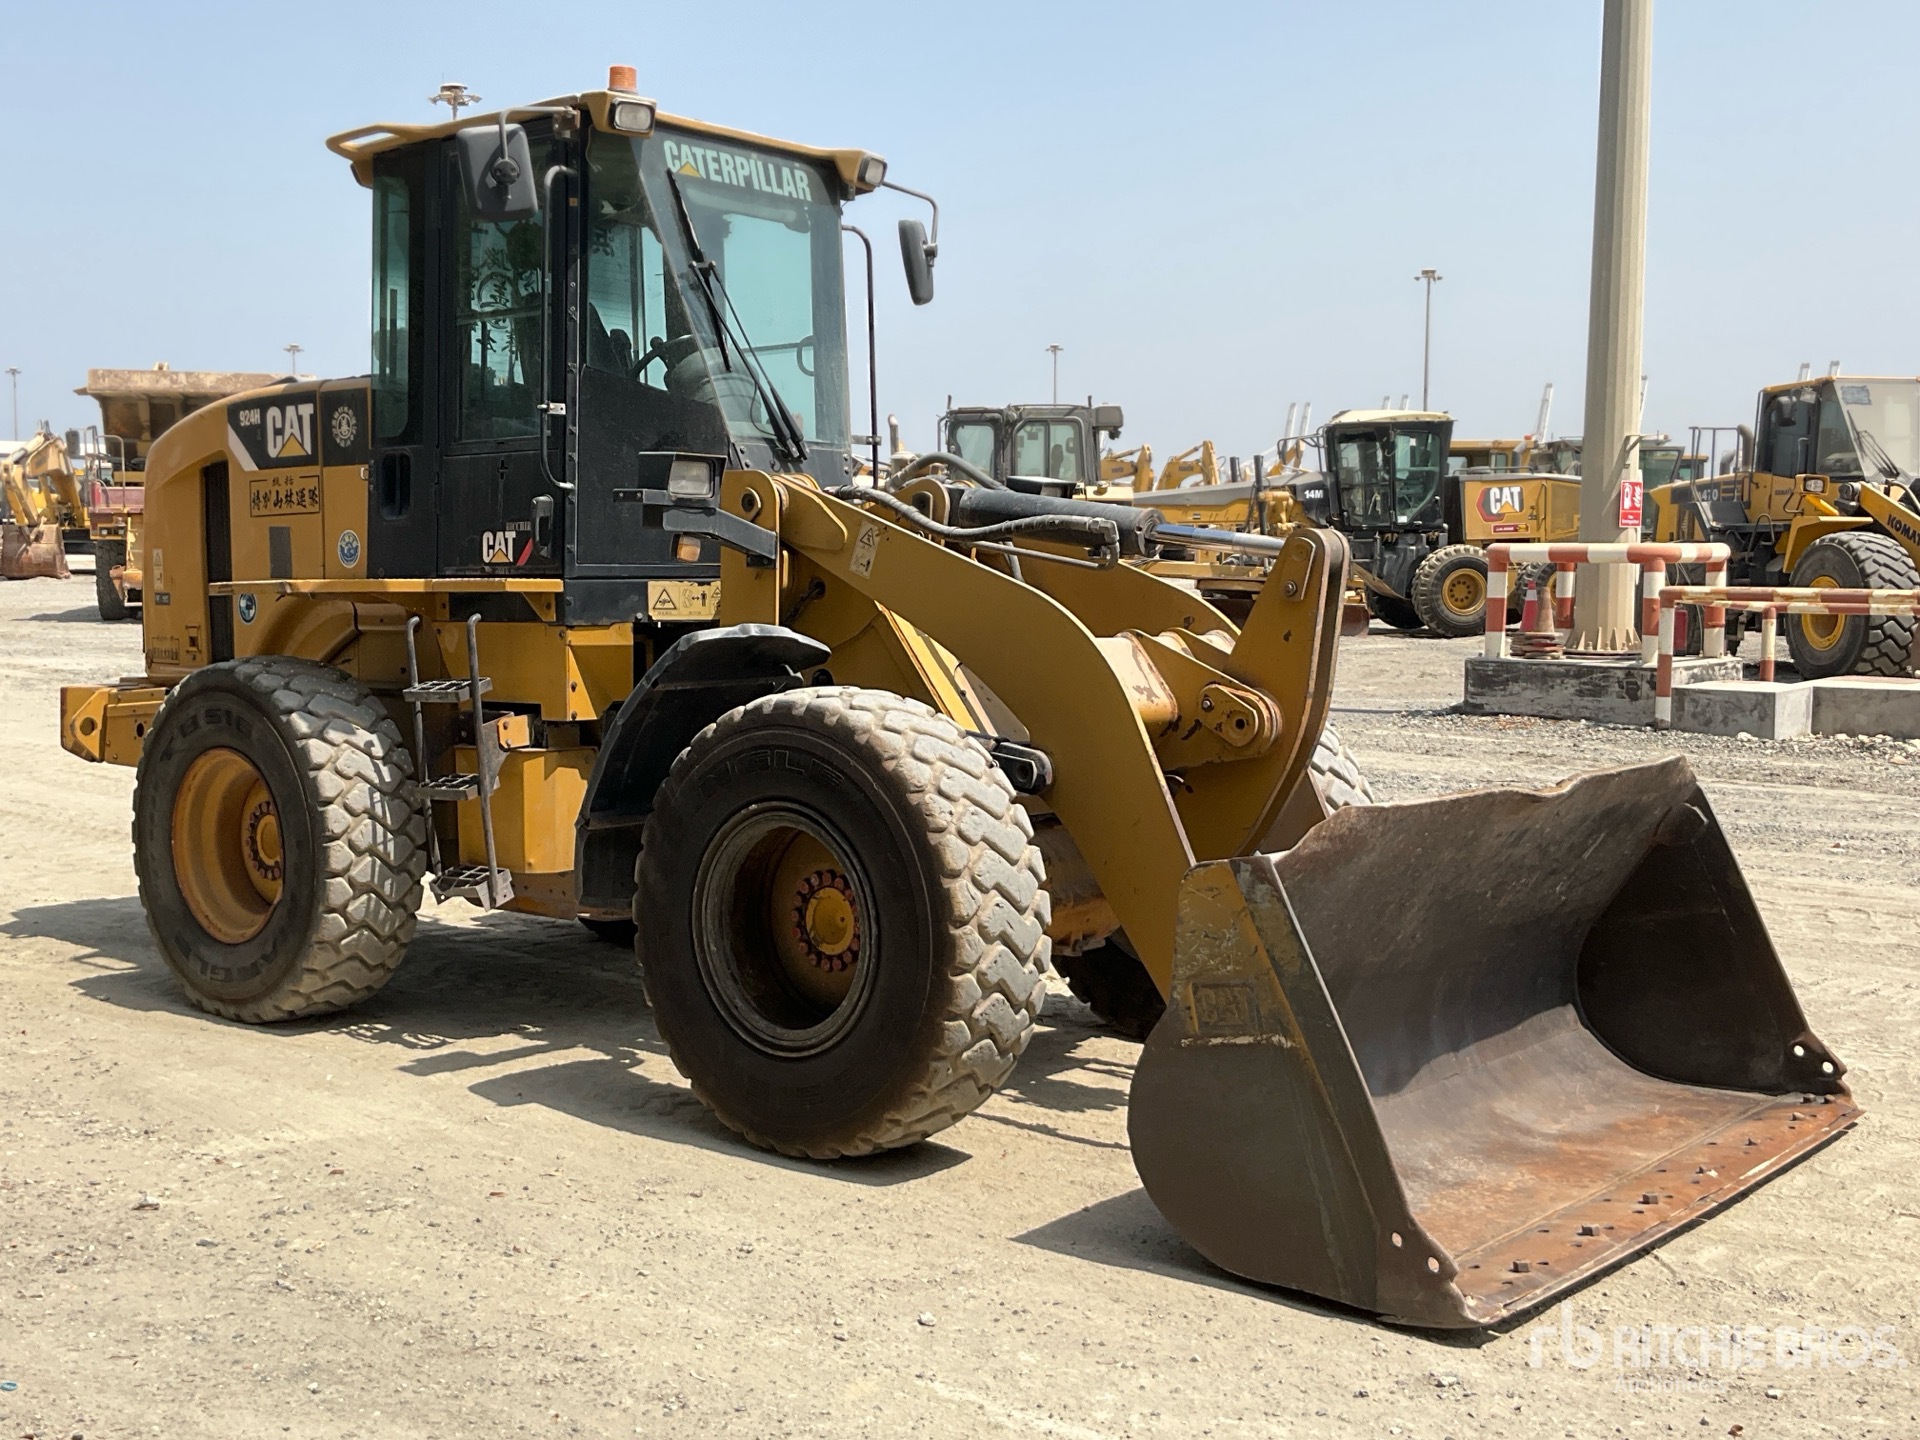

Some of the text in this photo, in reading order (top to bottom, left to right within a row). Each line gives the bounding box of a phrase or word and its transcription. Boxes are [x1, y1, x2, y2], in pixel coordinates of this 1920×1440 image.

[663, 140, 812, 201] CATERPILLAR
[240, 408, 261, 427] 924H
[266, 403, 314, 458] CAT
[1304, 489, 1324, 499] 14M
[1489, 486, 1520, 514] CAT
[482, 531, 516, 563] CAT
